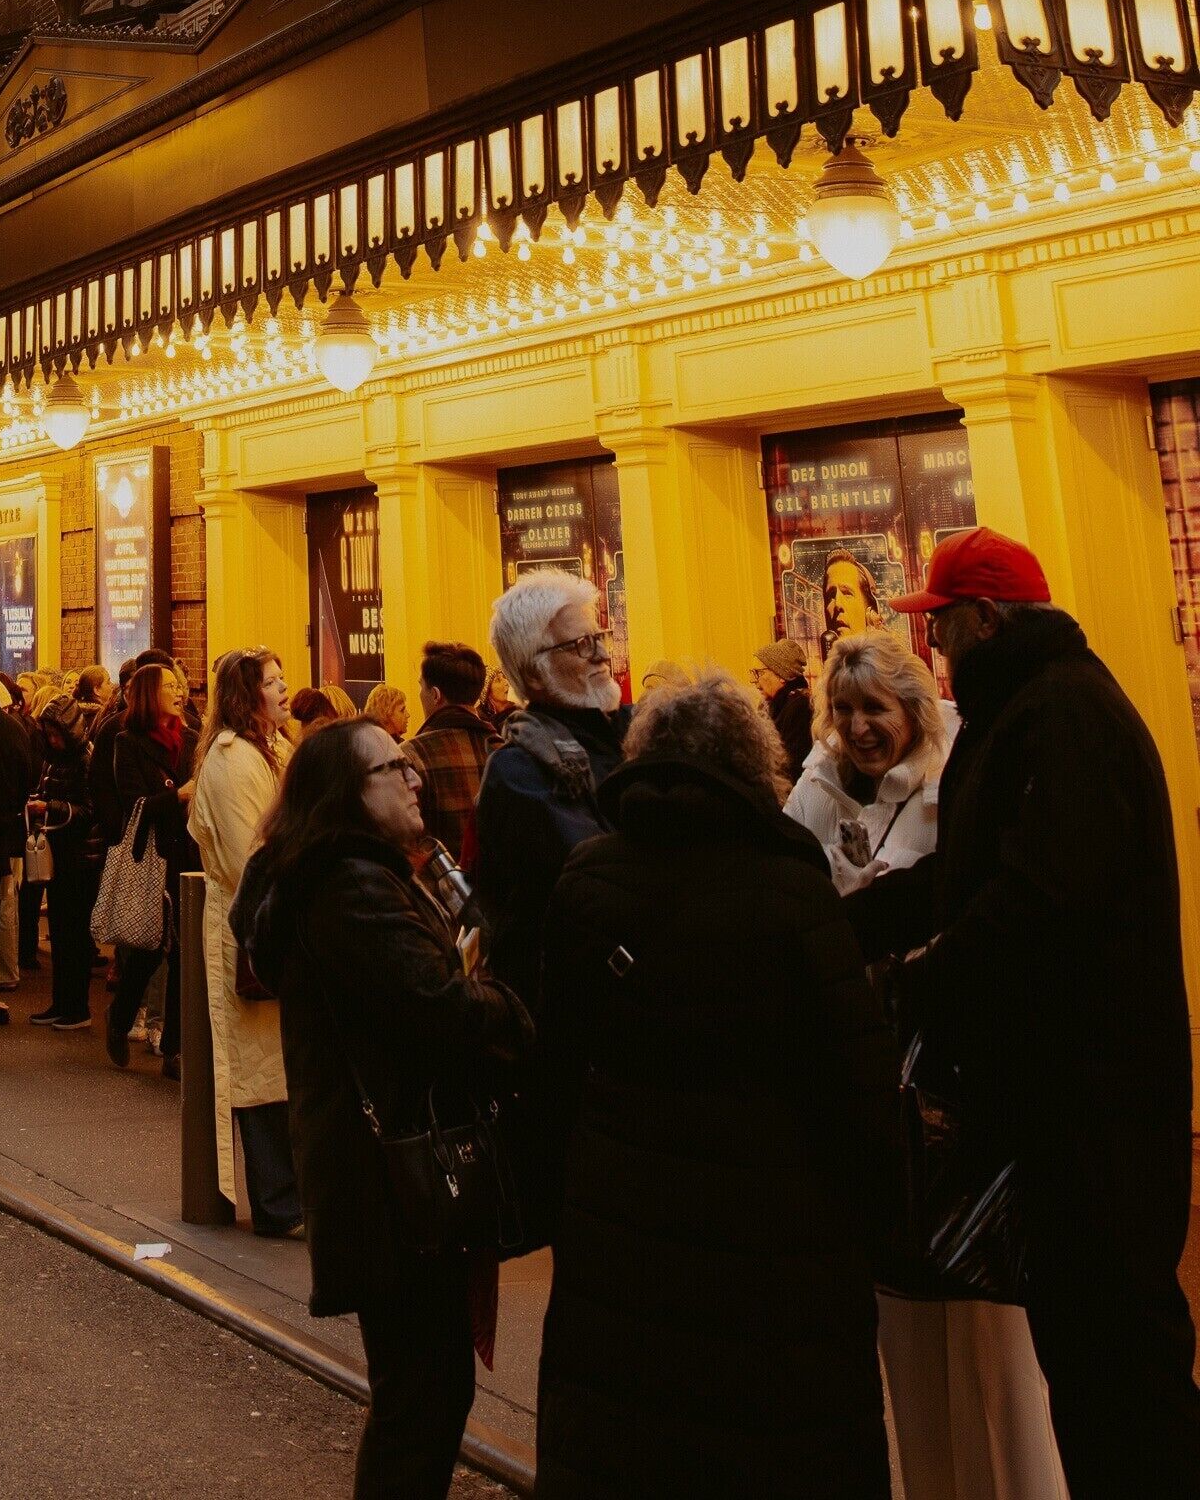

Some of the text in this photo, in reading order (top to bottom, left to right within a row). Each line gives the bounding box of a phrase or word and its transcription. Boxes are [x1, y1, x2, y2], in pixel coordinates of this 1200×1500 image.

[924, 450, 969, 470] MARC
[792, 461, 869, 483] DEZ DURON
[512, 492, 527, 501] TONY
[551, 487, 575, 497] WINNER
[775, 488, 893, 513] GIL BRENTLEY
[343, 510, 380, 532] WIN
[507, 502, 583, 522] DARREN CRISS
[528, 526, 571, 542] OLIVER
[350, 534, 374, 591] TONY
